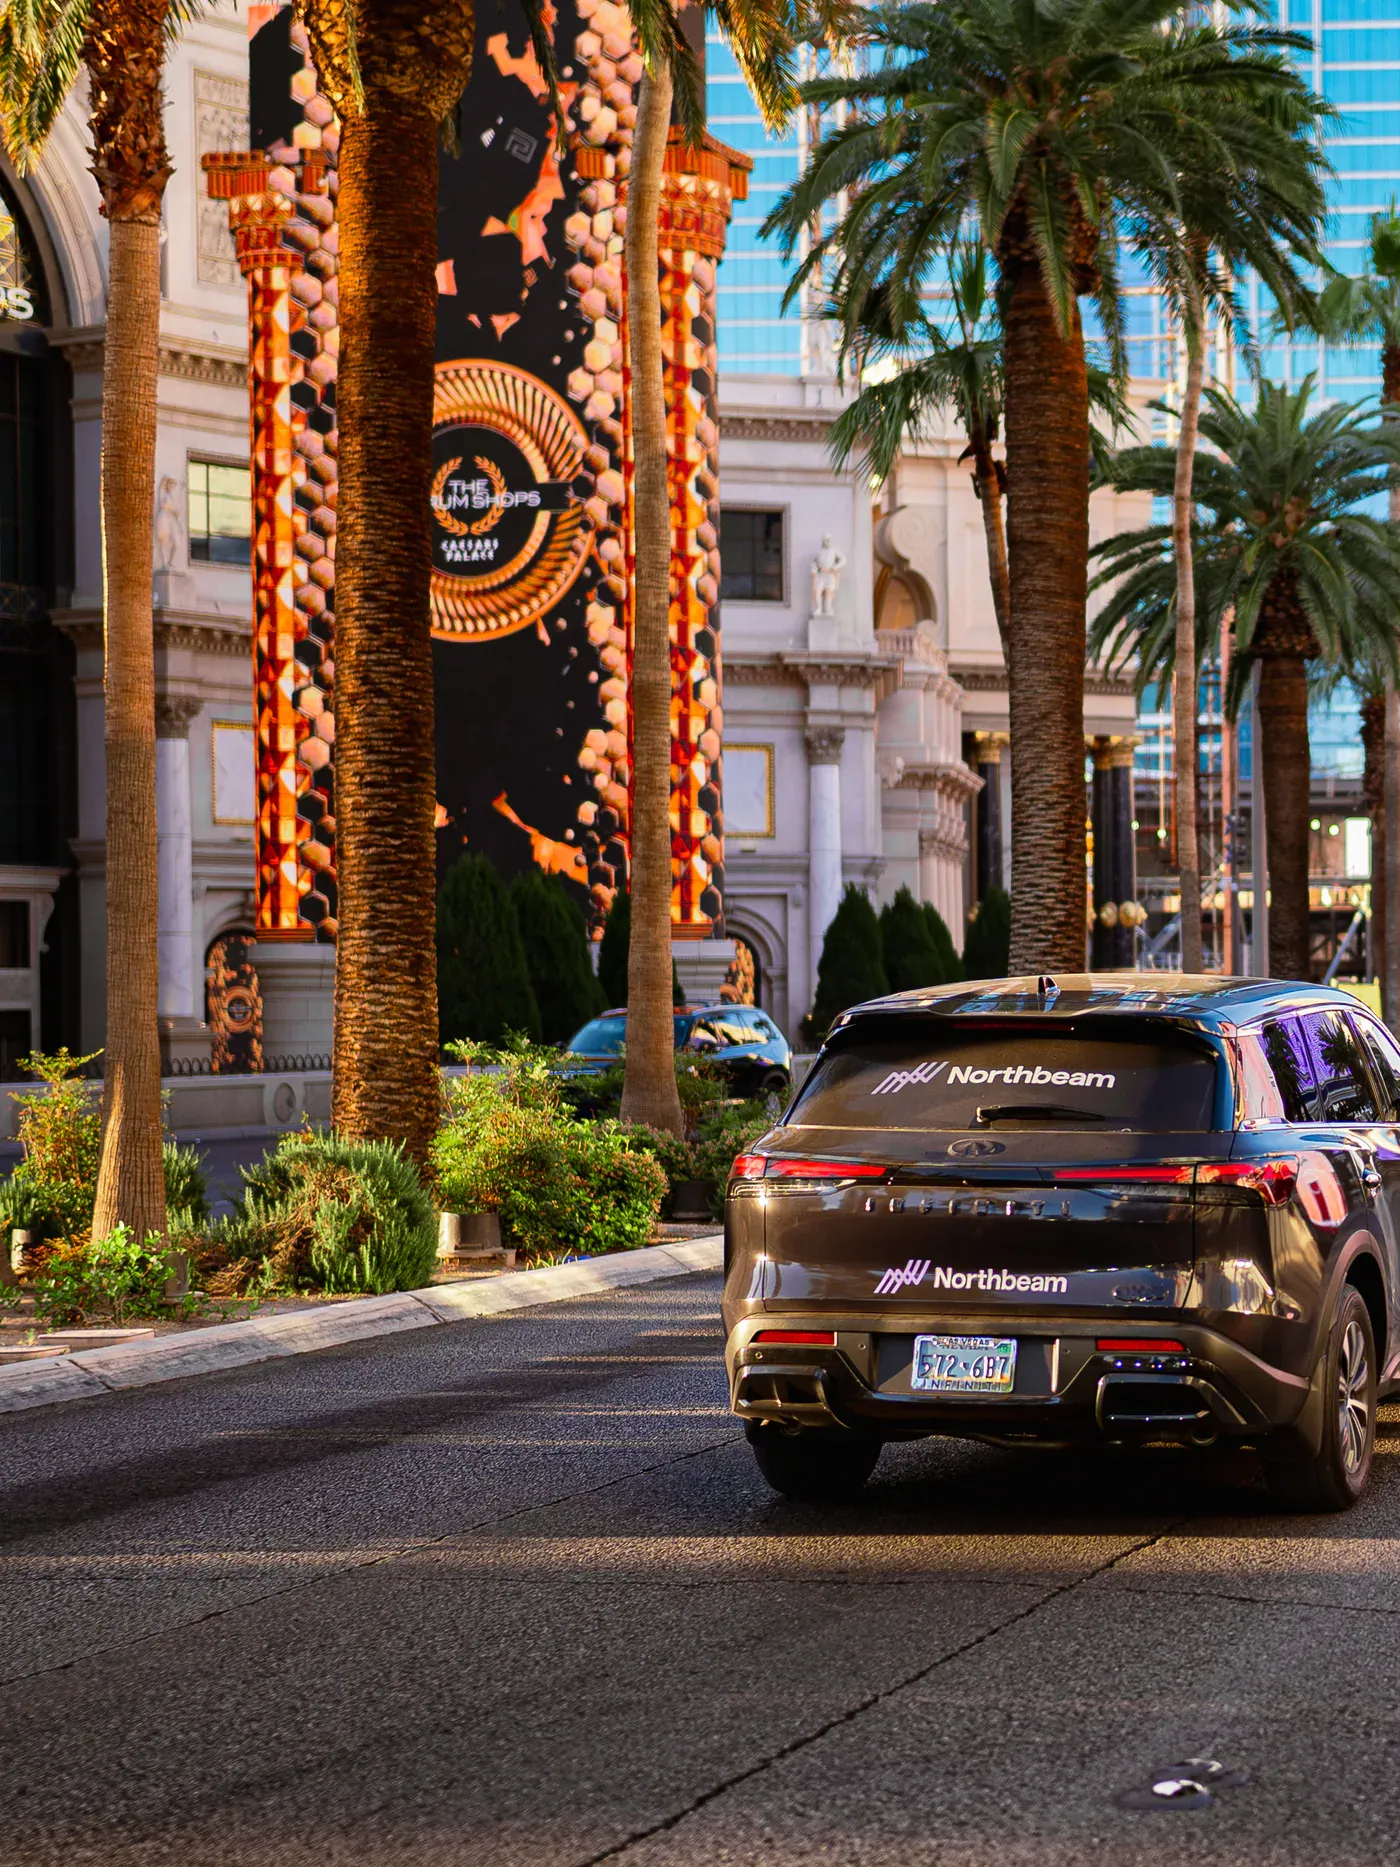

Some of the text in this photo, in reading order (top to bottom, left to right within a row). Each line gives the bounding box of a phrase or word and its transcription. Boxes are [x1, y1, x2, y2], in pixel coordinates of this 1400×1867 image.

[448, 479, 490, 495] THE
[430, 490, 541, 510] RUM SHOPS
[440, 538, 499, 551] CAESARS
[446, 550, 495, 562] PALACE
[947, 1066, 1116, 1088] Northbeam
[933, 1266, 1068, 1294] Northbeam
[962, 1338, 990, 1346] VEGAS
